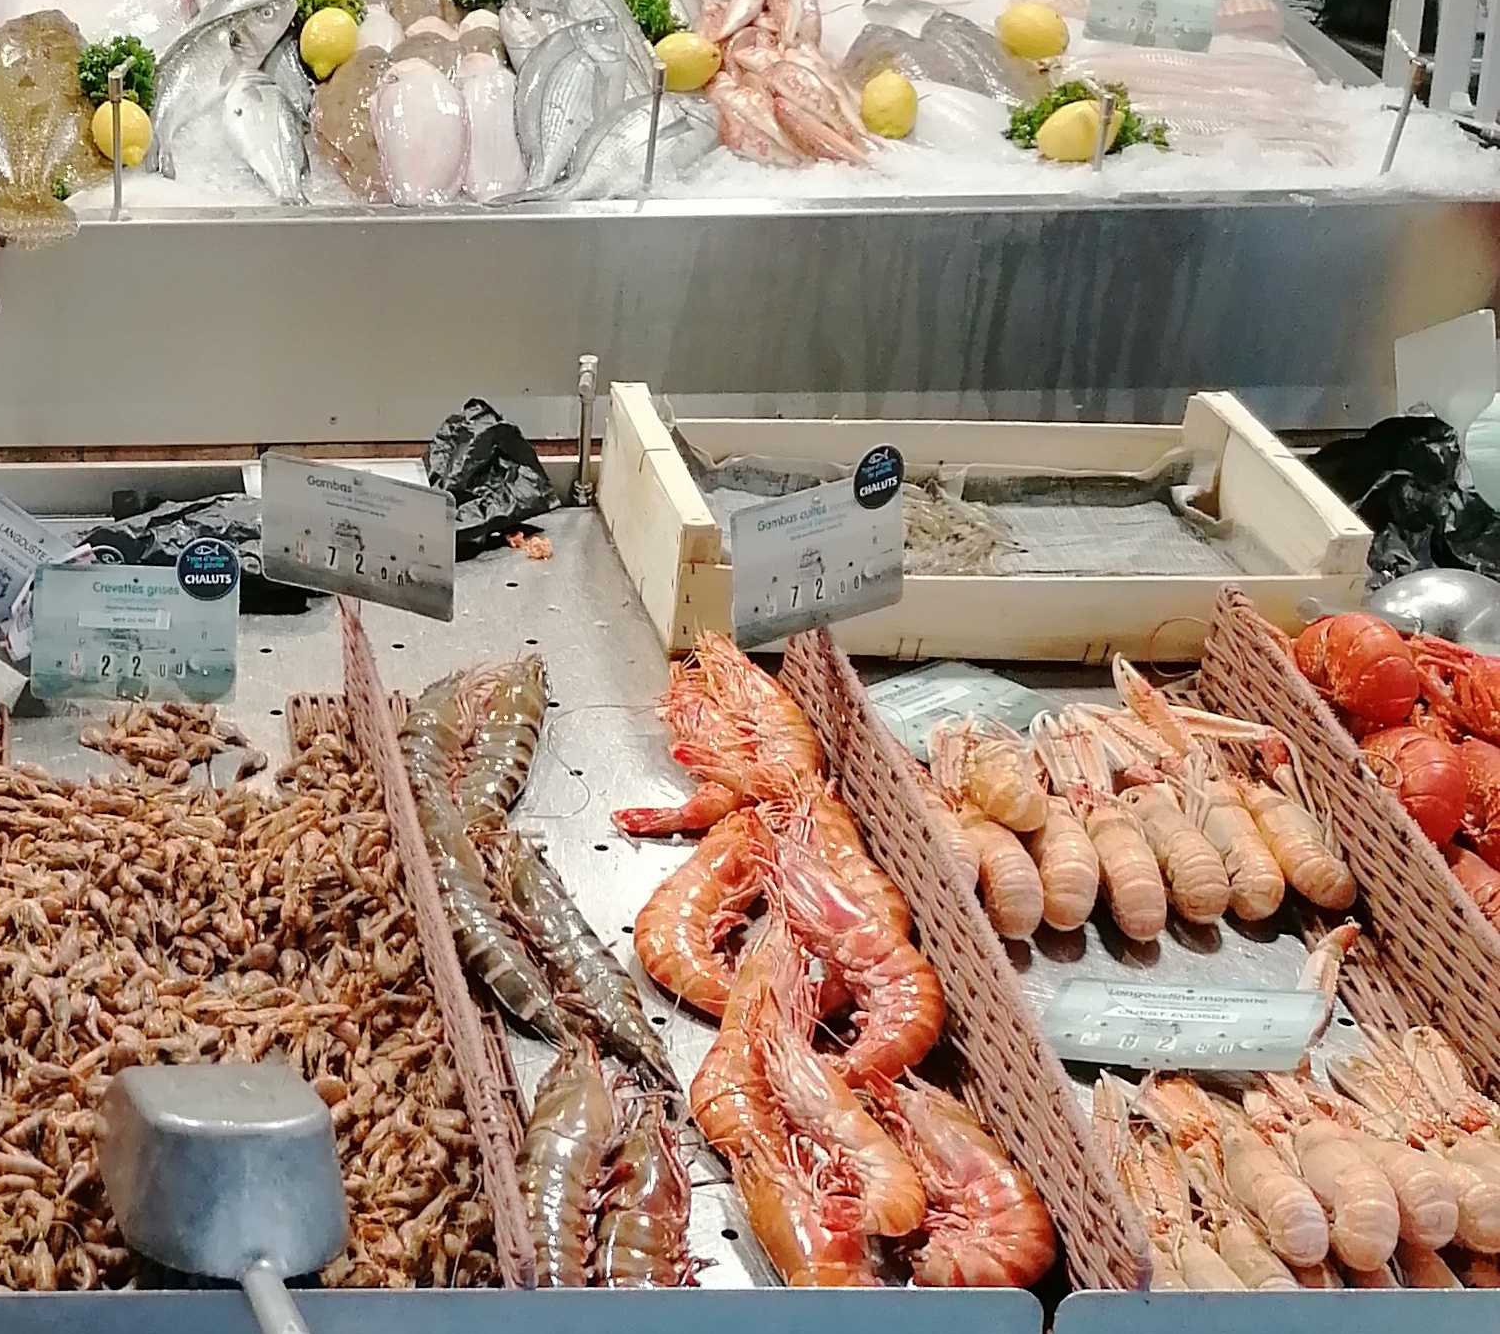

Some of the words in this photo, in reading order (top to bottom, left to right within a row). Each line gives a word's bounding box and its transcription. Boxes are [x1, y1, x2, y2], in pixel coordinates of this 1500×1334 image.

[306, 474, 353, 494] Gambas
[859, 475, 899, 498] CHALUTS
[757, 511, 798, 533] Gambas
[799, 503, 828, 520] cuites
[184, 573, 232, 586] CHALUTS
[92, 581, 145, 596] Crevettes
[146, 583, 180, 598] grises
[1107, 987, 1196, 1003] Langoustine
